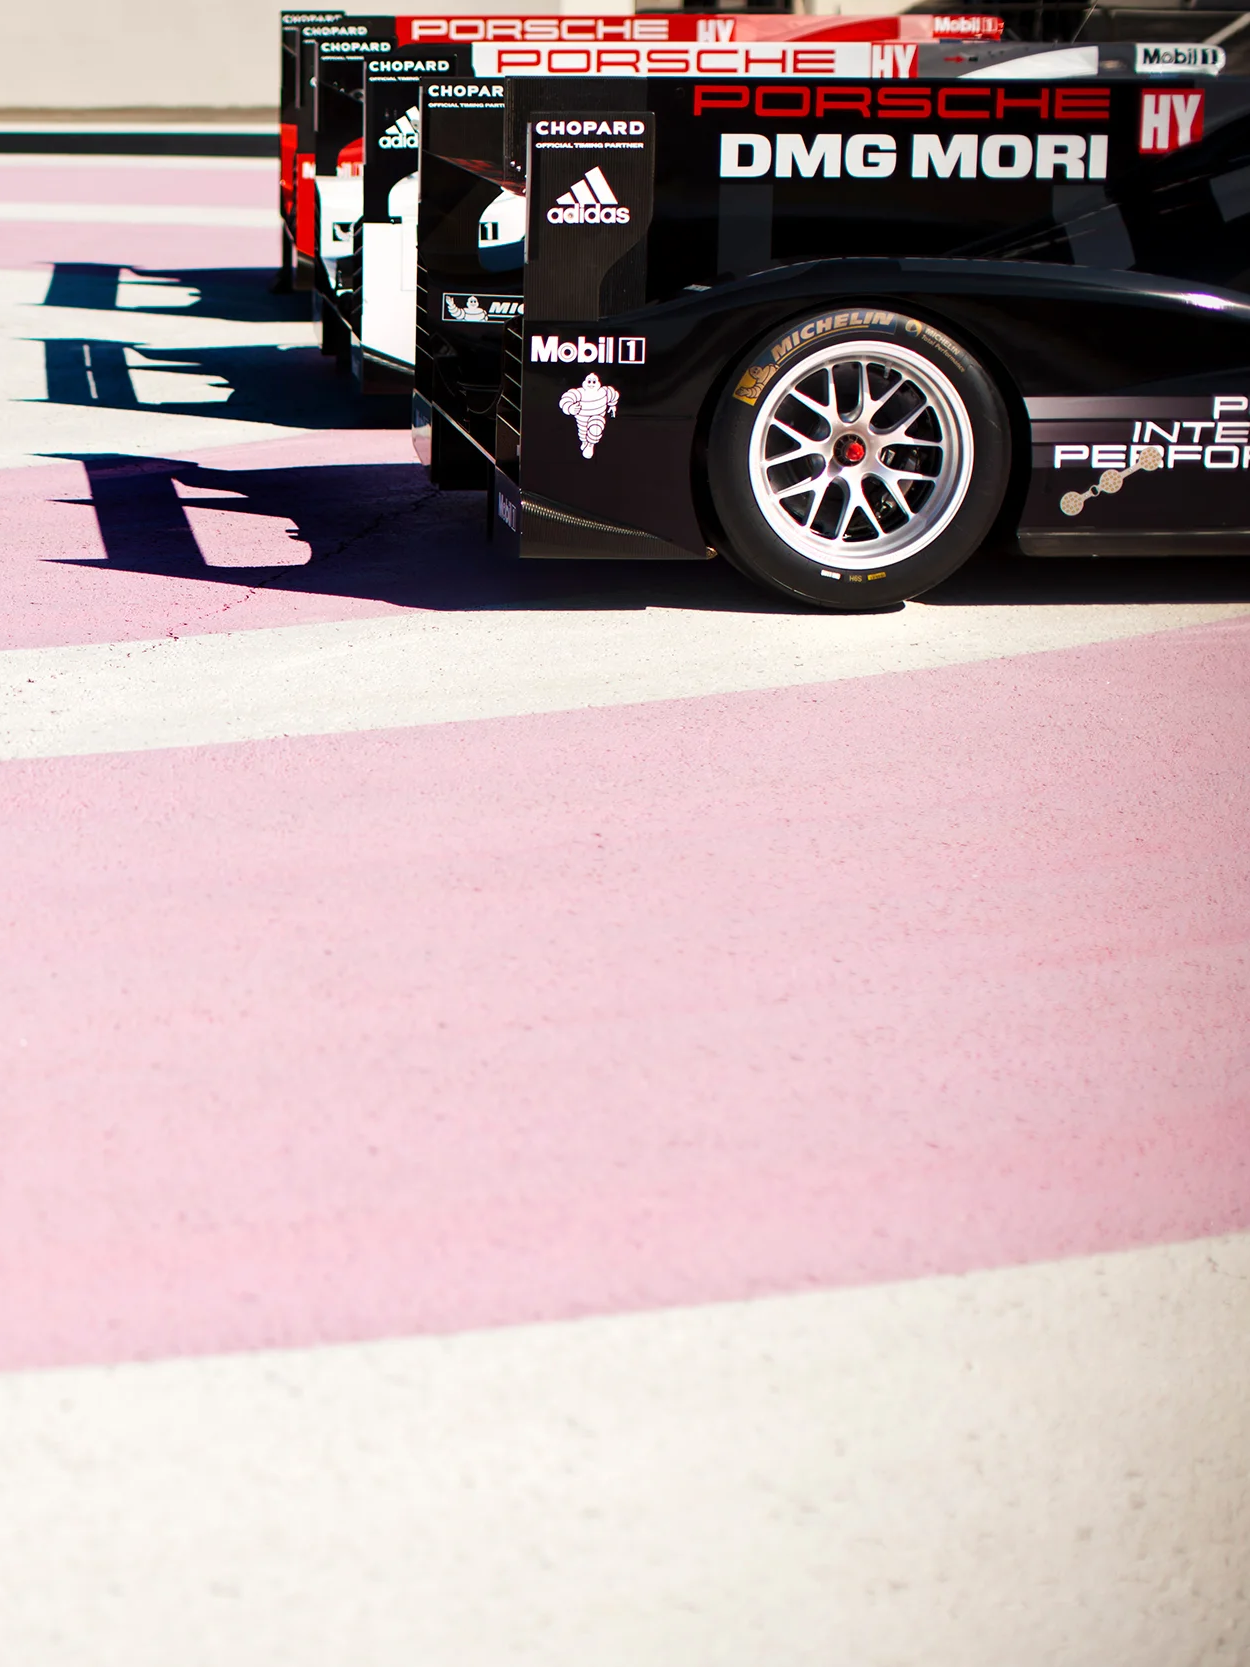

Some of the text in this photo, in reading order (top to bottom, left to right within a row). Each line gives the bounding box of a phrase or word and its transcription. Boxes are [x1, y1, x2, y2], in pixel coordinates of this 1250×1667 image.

[302, 25, 368, 37] CHOPARD
[411, 18, 670, 41] PORSCHE
[696, 19, 735, 42] HY
[934, 16, 981, 33] Mobil
[320, 41, 392, 53] CHOPARD
[1142, 47, 1198, 65] Mobil
[368, 60, 450, 73] CHOPARD
[497, 49, 835, 73] PORSCHE
[871, 44, 918, 79] HY
[428, 85, 504, 98] CHOPAR
[693, 85, 1111, 119] PORSCHE
[535, 120, 646, 136] CHOPARD
[1141, 94, 1202, 150] HY
[378, 132, 420, 150] adid
[719, 133, 1108, 179] DMG MORI
[546, 203, 631, 225] adidas
[770, 311, 895, 362] MICHELIN
[924, 328, 960, 355] MICHELIN
[531, 335, 614, 363] Mobil
